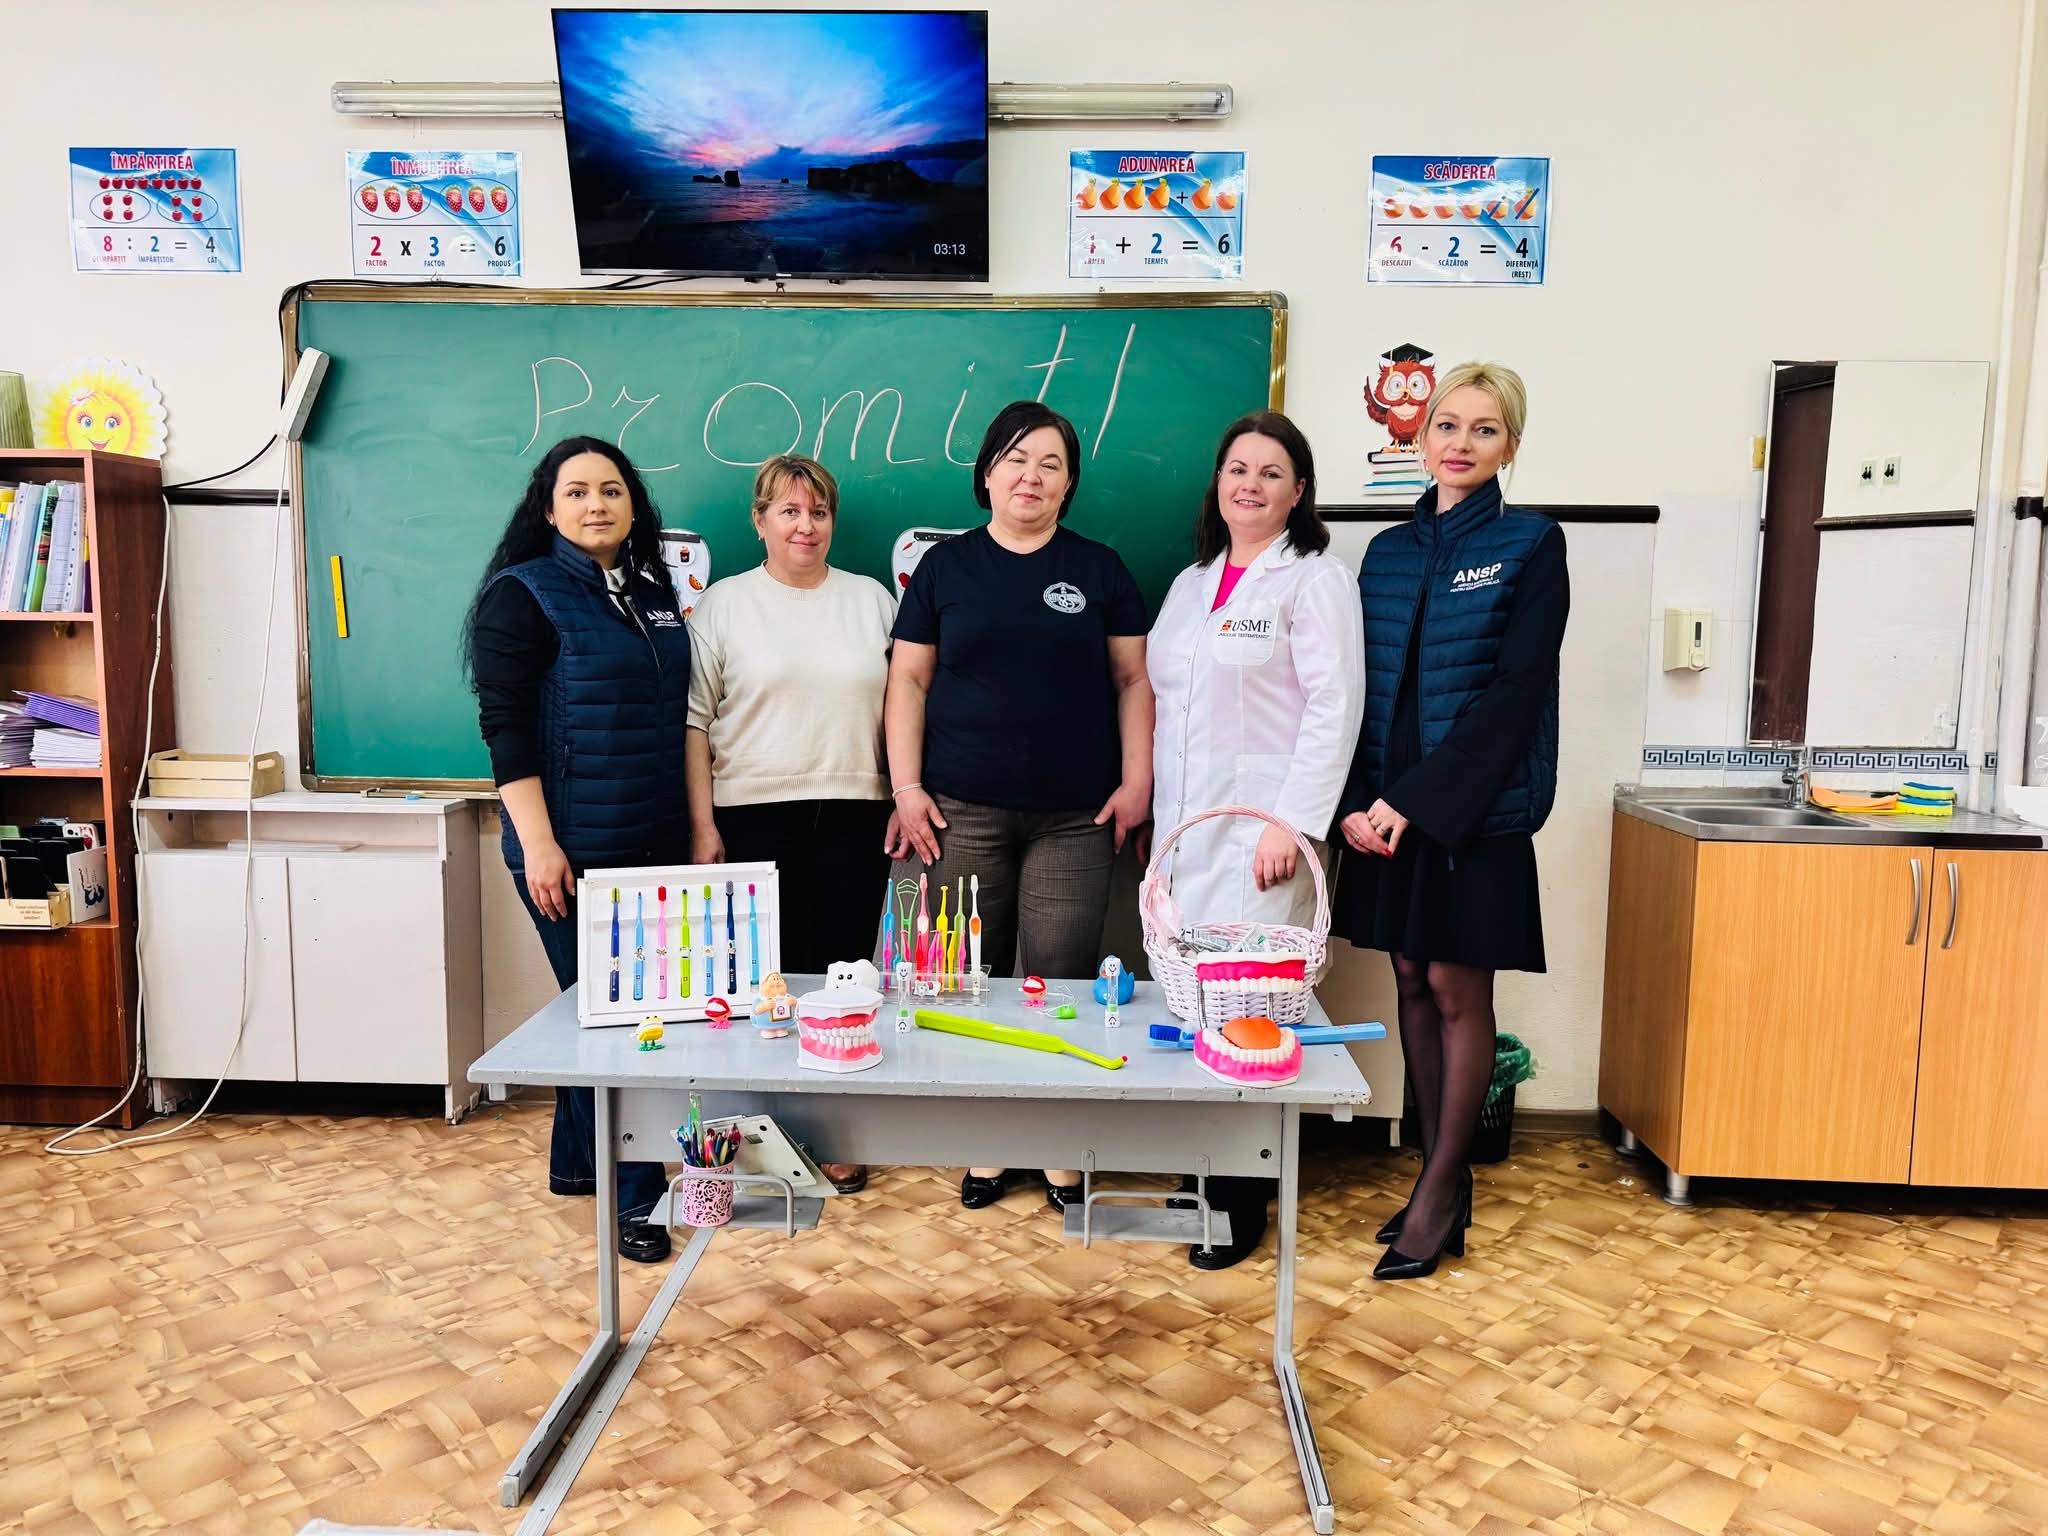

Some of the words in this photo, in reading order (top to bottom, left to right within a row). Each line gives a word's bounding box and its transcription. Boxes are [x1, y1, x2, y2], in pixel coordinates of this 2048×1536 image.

[1119, 157, 1195, 173] ADUNAREA
[1424, 161, 1496, 180] SCĂDEREA
[103, 235, 113, 252] 8
[149, 235, 160, 253] 2
[174, 241, 188, 250] =
[205, 235, 216, 253] 4
[370, 236, 382, 257] 2
[429, 236, 440, 257] 3
[460, 243, 476, 253] =
[494, 236, 506, 257] 6
[934, 243, 966, 255] 03:13
[1116, 236, 1131, 254] +
[1151, 233, 1162, 254] 2
[1183, 240, 1198, 250] =
[1218, 233, 1230, 255] 6
[1447, 236, 1460, 258] 2
[1480, 244, 1496, 254] =
[1515, 237, 1529, 259] 4
[365, 259, 388, 268] FACTOR
[423, 259, 446, 268] FACTOR
[487, 259, 512, 268] PRODUS
[1144, 257, 1169, 265] TERMEN
[1511, 270, 1532, 279] (REST)
[1453, 562, 1502, 584] ANSP
[1231, 619, 1272, 633] USMF
